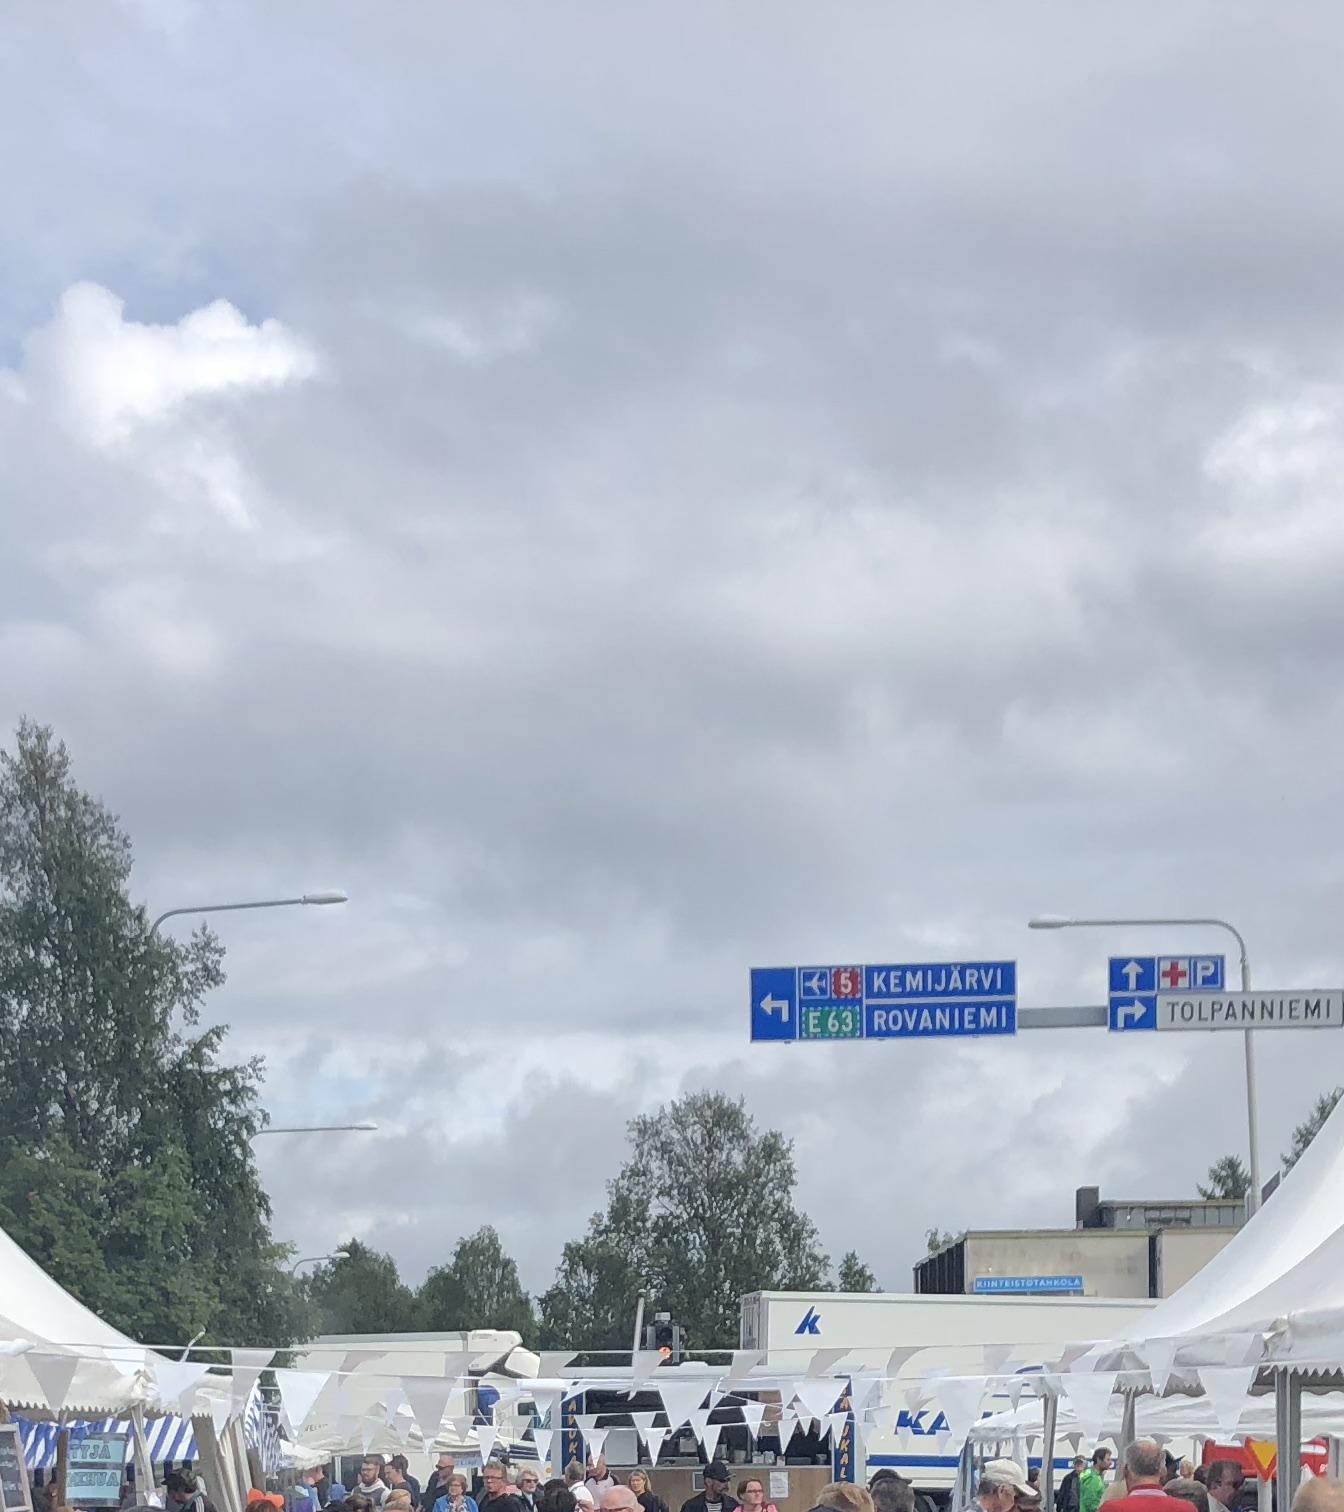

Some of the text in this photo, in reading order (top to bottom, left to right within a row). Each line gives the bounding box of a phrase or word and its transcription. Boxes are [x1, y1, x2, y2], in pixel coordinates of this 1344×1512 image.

[839, 967, 1004, 994] 5 KEMIJÄRVI
[1194, 962, 1217, 985] P
[828, 1009, 853, 1033] 63
[873, 1006, 1008, 1031] ROVANIEMI
[1166, 998, 1332, 1022] TOLPANNIEMI
